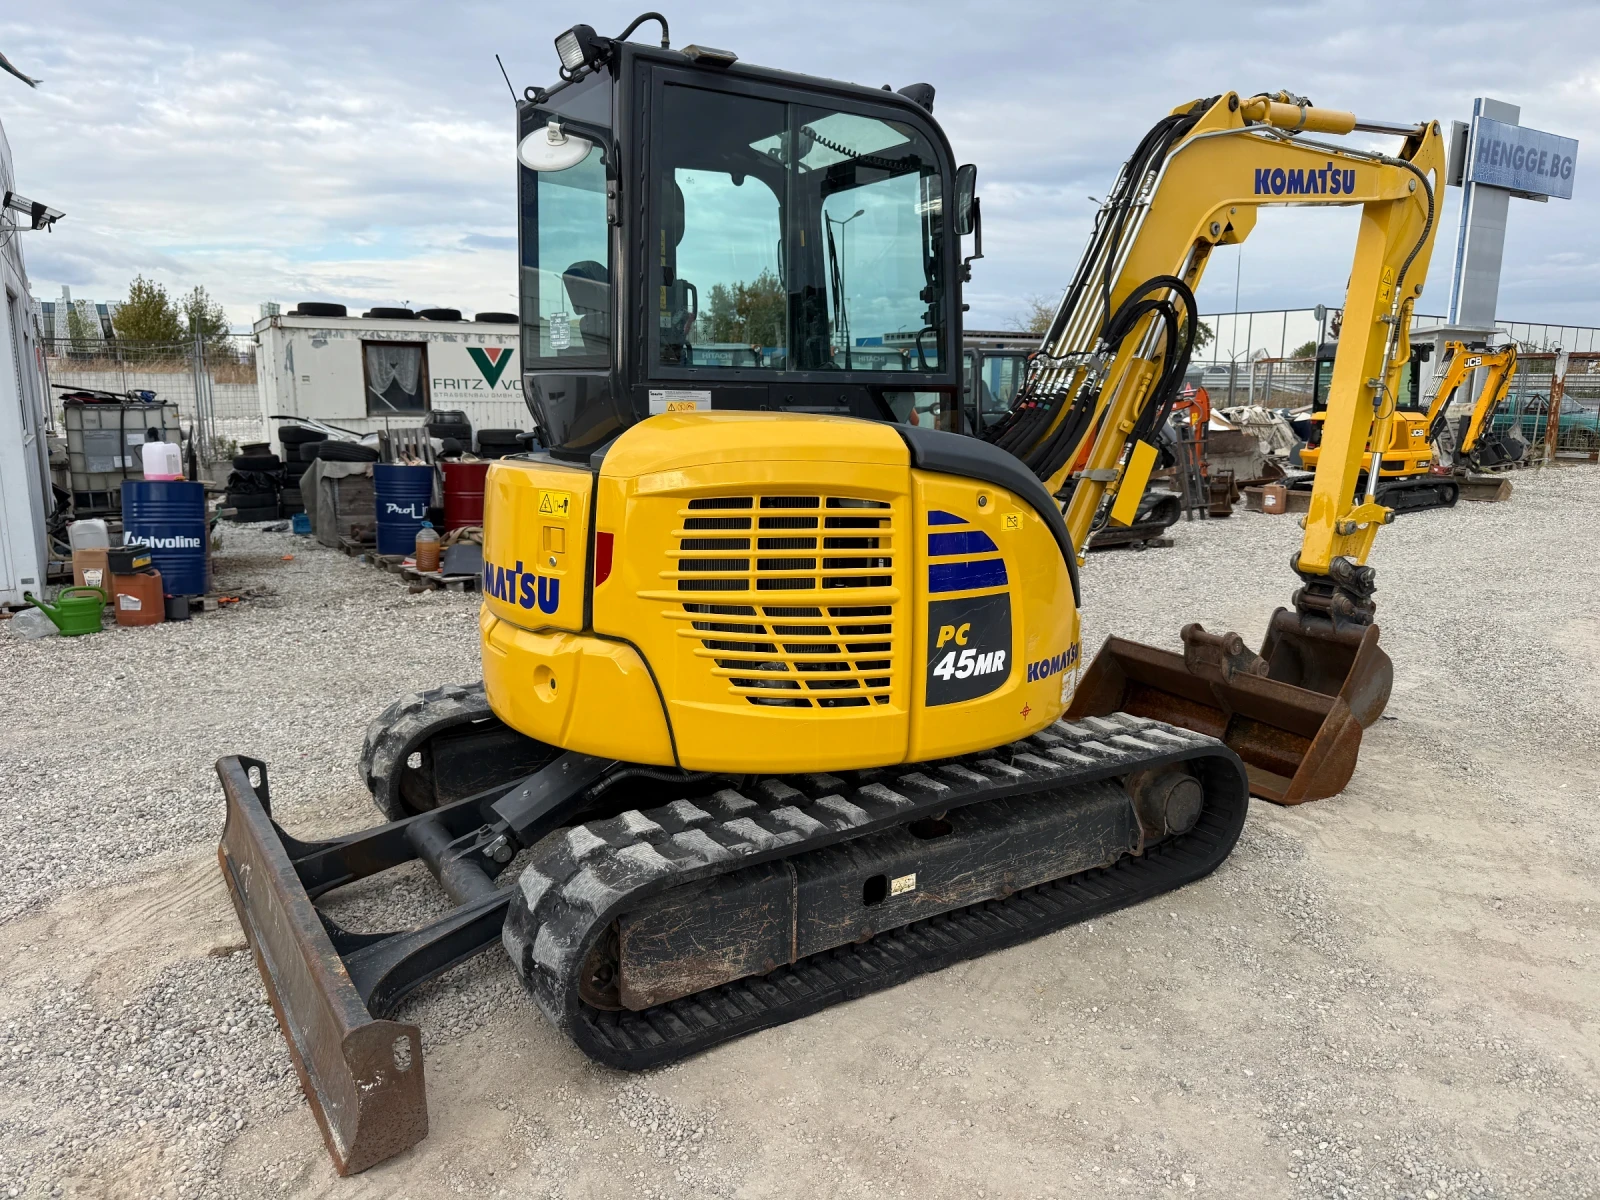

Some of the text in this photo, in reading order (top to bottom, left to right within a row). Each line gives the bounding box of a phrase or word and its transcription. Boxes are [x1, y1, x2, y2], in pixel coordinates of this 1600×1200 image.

[1478, 137, 1573, 180] HENGGE.BG
[1254, 162, 1356, 195] KOMATSU
[858, 354, 885, 363] HITACHI
[1464, 356, 1482, 368] JCB
[433, 378, 484, 390] FRITZ
[1411, 429, 1424, 437] JCB
[131, 536, 201, 549] Valvoline
[482, 560, 560, 615] MATSU
[936, 623, 971, 648] PC
[933, 648, 1006, 681] 45MR
[1027, 641, 1079, 683] KOMATSU
